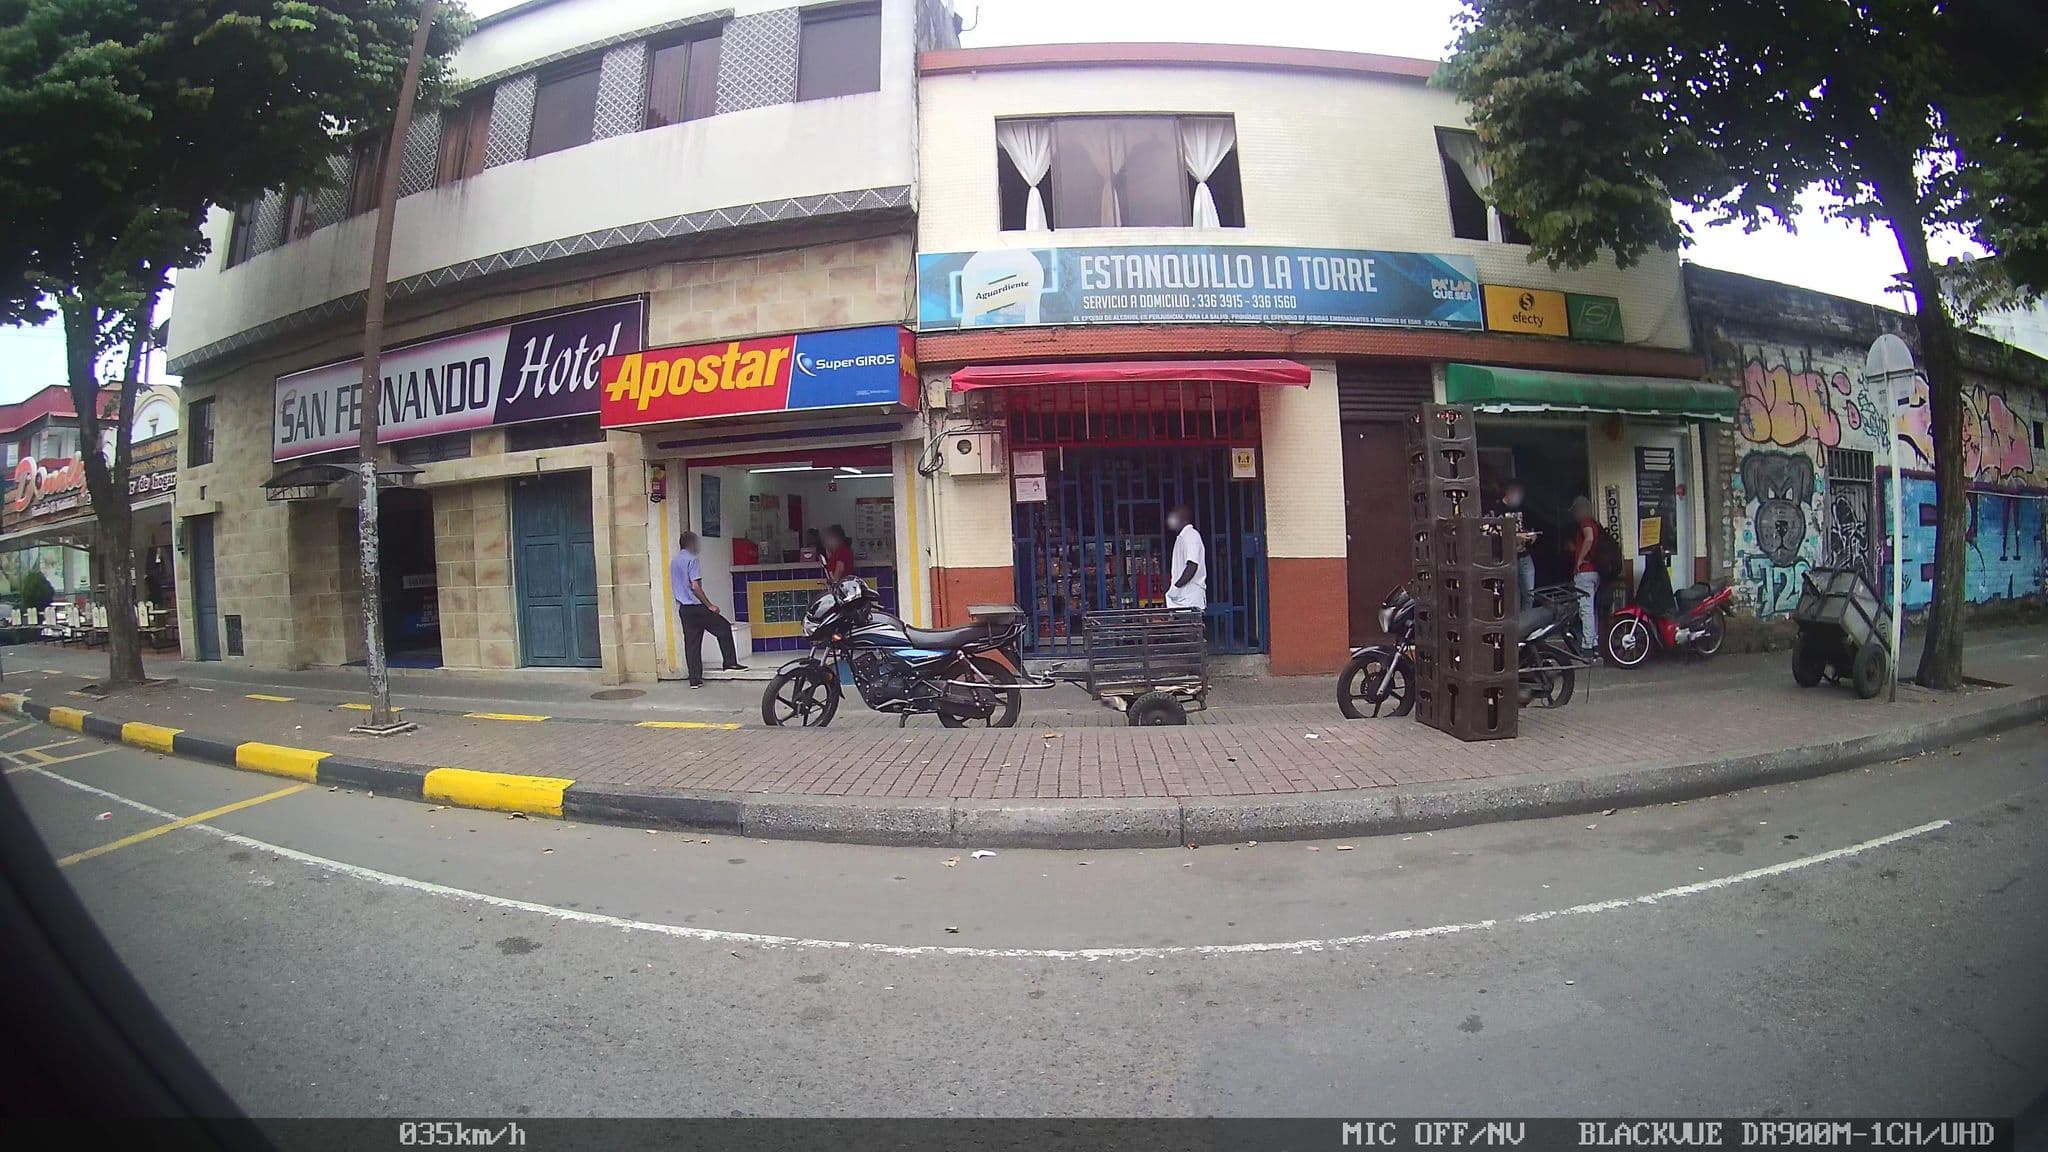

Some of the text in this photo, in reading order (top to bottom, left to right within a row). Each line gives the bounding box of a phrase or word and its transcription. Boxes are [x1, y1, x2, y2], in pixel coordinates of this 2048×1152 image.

[975, 281, 1029, 300] Aguardiente
[1080, 254, 1378, 293] ESTANQUILLO LA TORRE
[1083, 294, 1128, 309] SERVICIO
[1130, 294, 1138, 308] A
[1140, 294, 1189, 308] DOMICILIO
[1198, 294, 1217, 308] 336
[1220, 294, 1243, 308] 3915
[1252, 294, 1272, 309] 336
[1274, 295, 1297, 309] 1560
[1512, 312, 1544, 328] efecty
[505, 320, 623, 405] Hotel
[605, 342, 790, 411] Apostar
[281, 356, 491, 444] SAN FENANDO
[1608, 489, 1619, 541] FOTOCO
